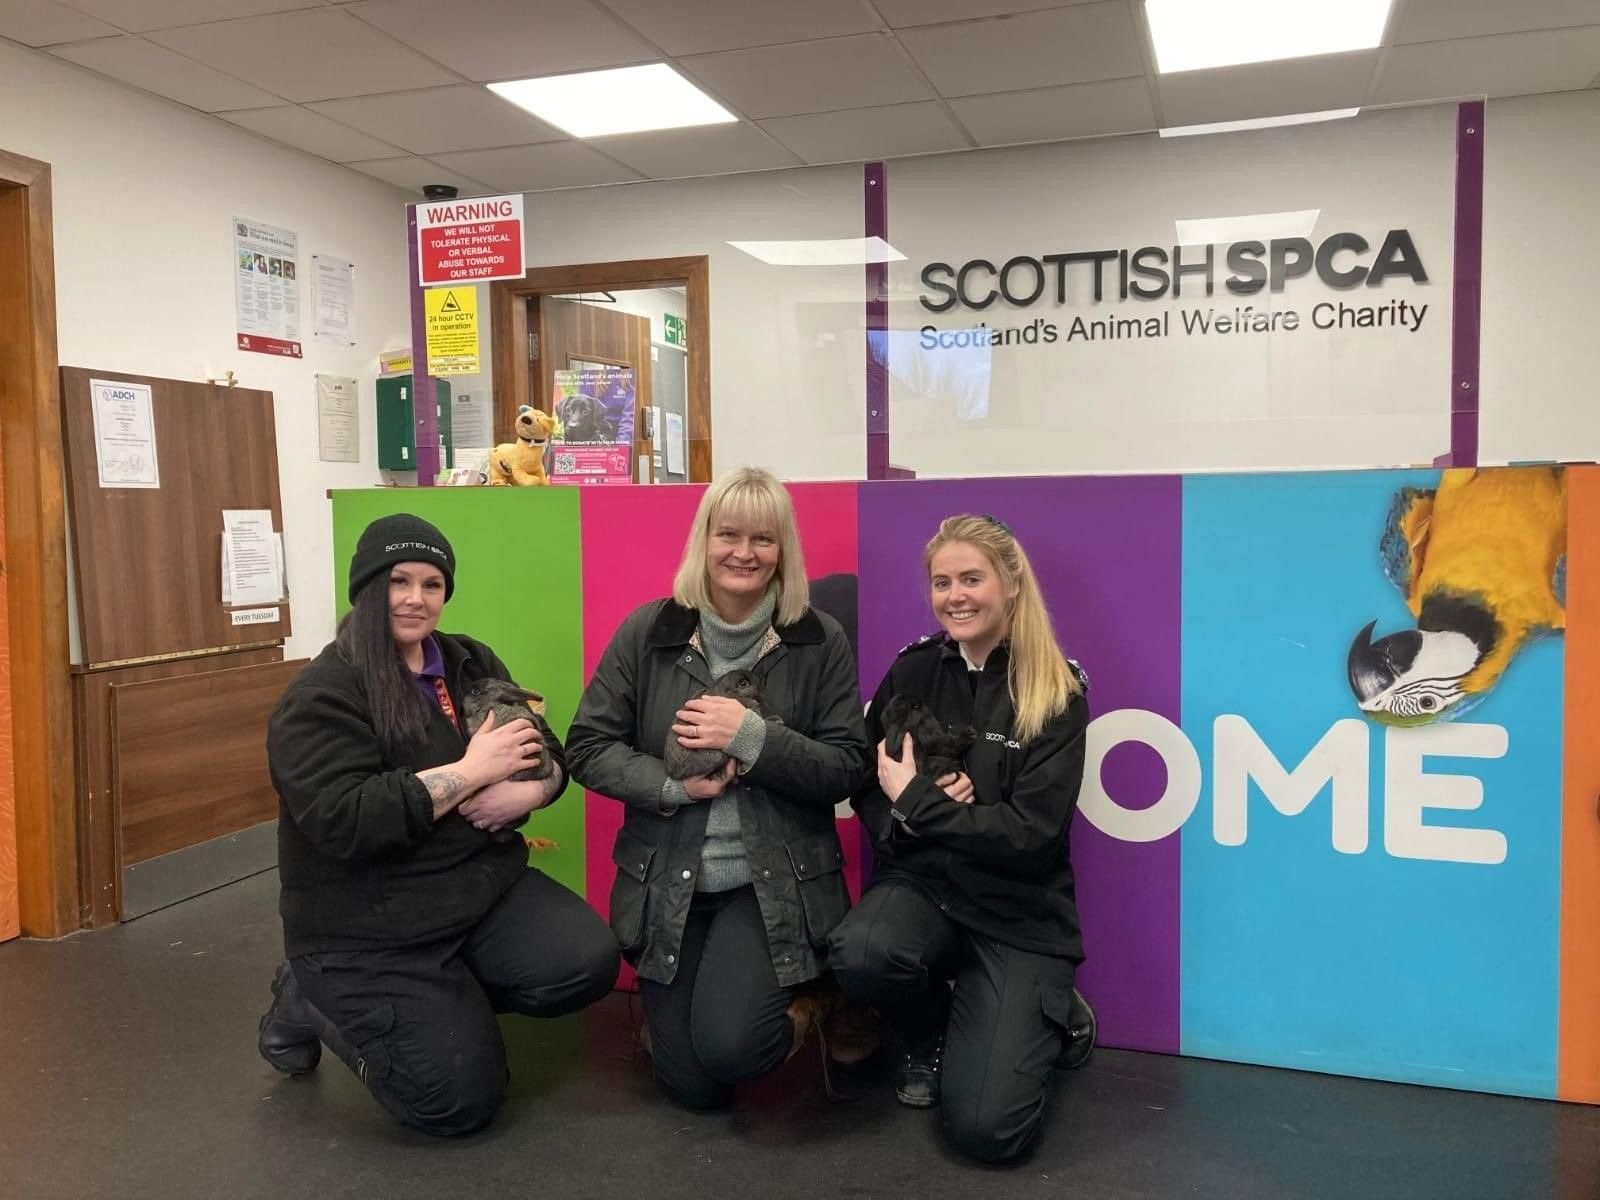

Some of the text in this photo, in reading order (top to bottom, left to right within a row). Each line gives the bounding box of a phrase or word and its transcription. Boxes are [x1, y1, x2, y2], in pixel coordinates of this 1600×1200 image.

[427, 201, 512, 224] WARNING
[444, 224, 495, 236] WE WILL NOT
[431, 234, 511, 248] TOLERATE PHYSICAL
[462, 246, 493, 256] VERBAL
[438, 256, 504, 268] ABUSE TOWARDS
[451, 267, 492, 278] OUR STAFF
[918, 229, 1429, 312] SCOTTISH SPCA
[440, 322, 471, 331] operation
[920, 301, 1428, 350] Scotland's Animal Welfare Charity
[112, 390, 135, 400] ADCH
[385, 542, 430, 552] SCOTTISH
[235, 611, 274, 622] EVERY TUESDAY
